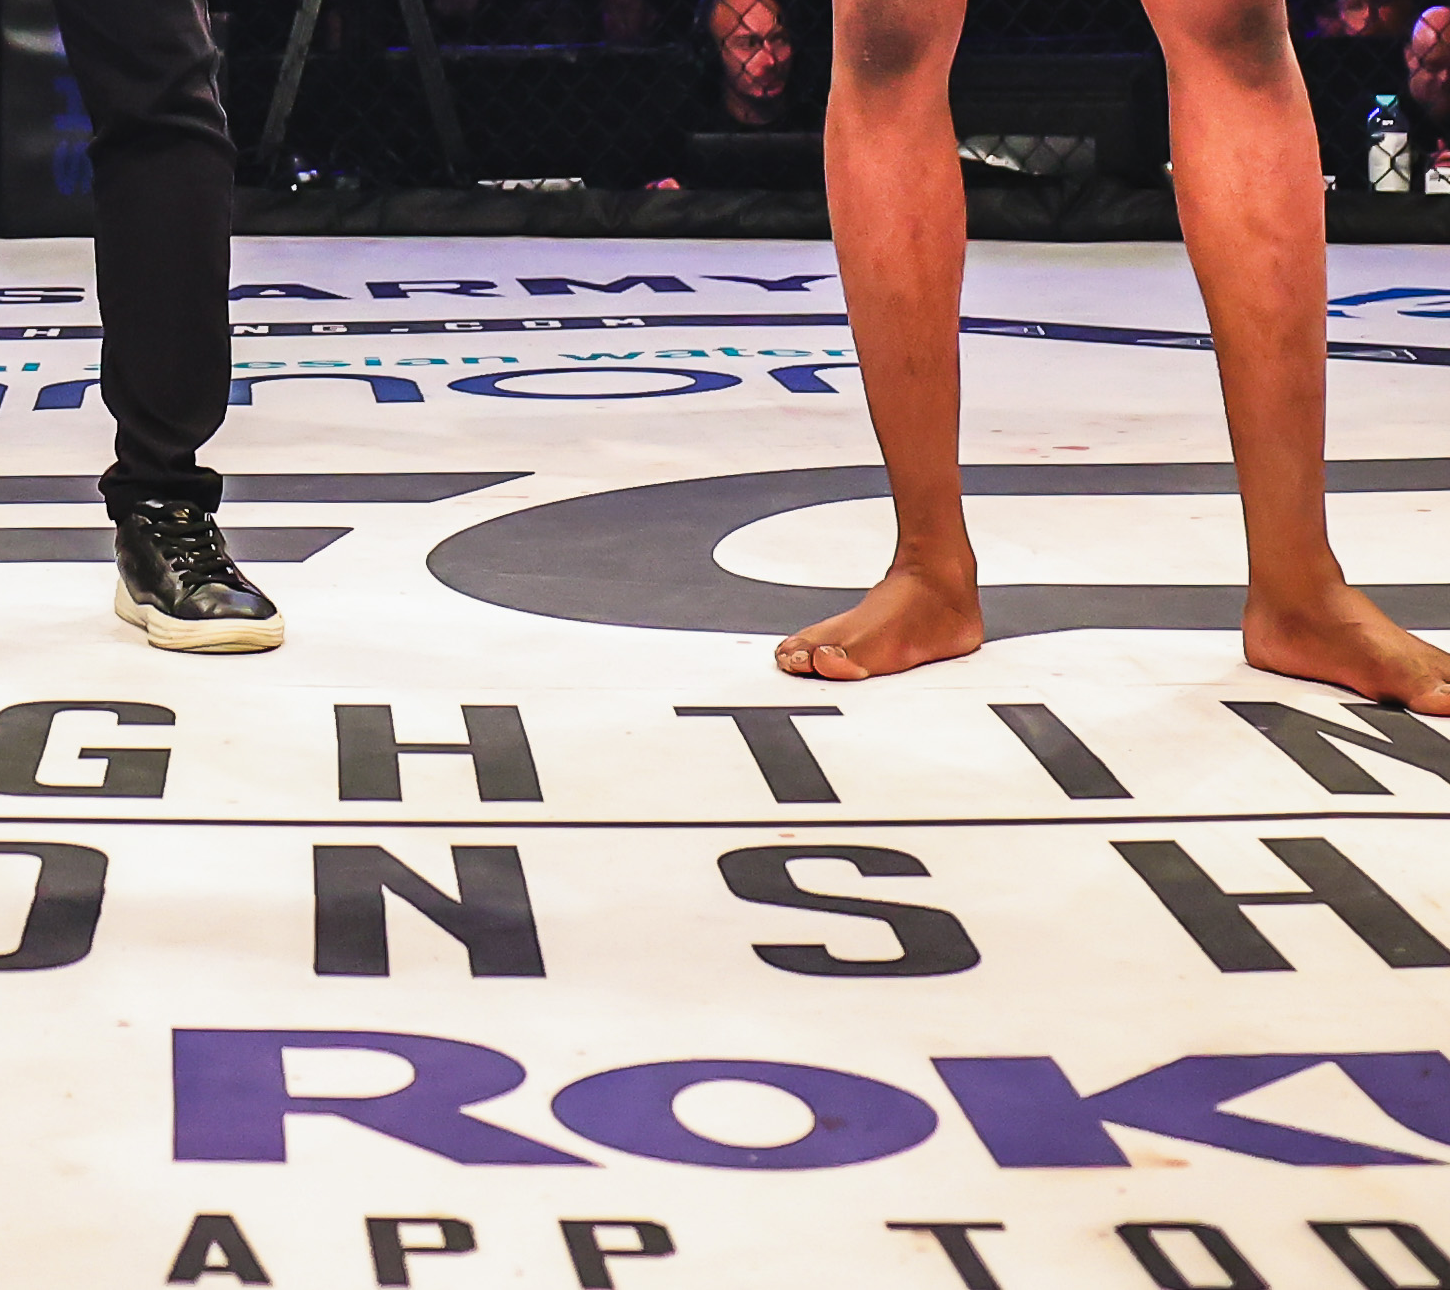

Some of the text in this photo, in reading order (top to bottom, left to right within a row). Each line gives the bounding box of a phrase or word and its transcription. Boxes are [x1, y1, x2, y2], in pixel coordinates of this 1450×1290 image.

[225, 274, 837, 300] ARMY
[556, 346, 855, 362] water
[165, 1214, 677, 1289] APP
